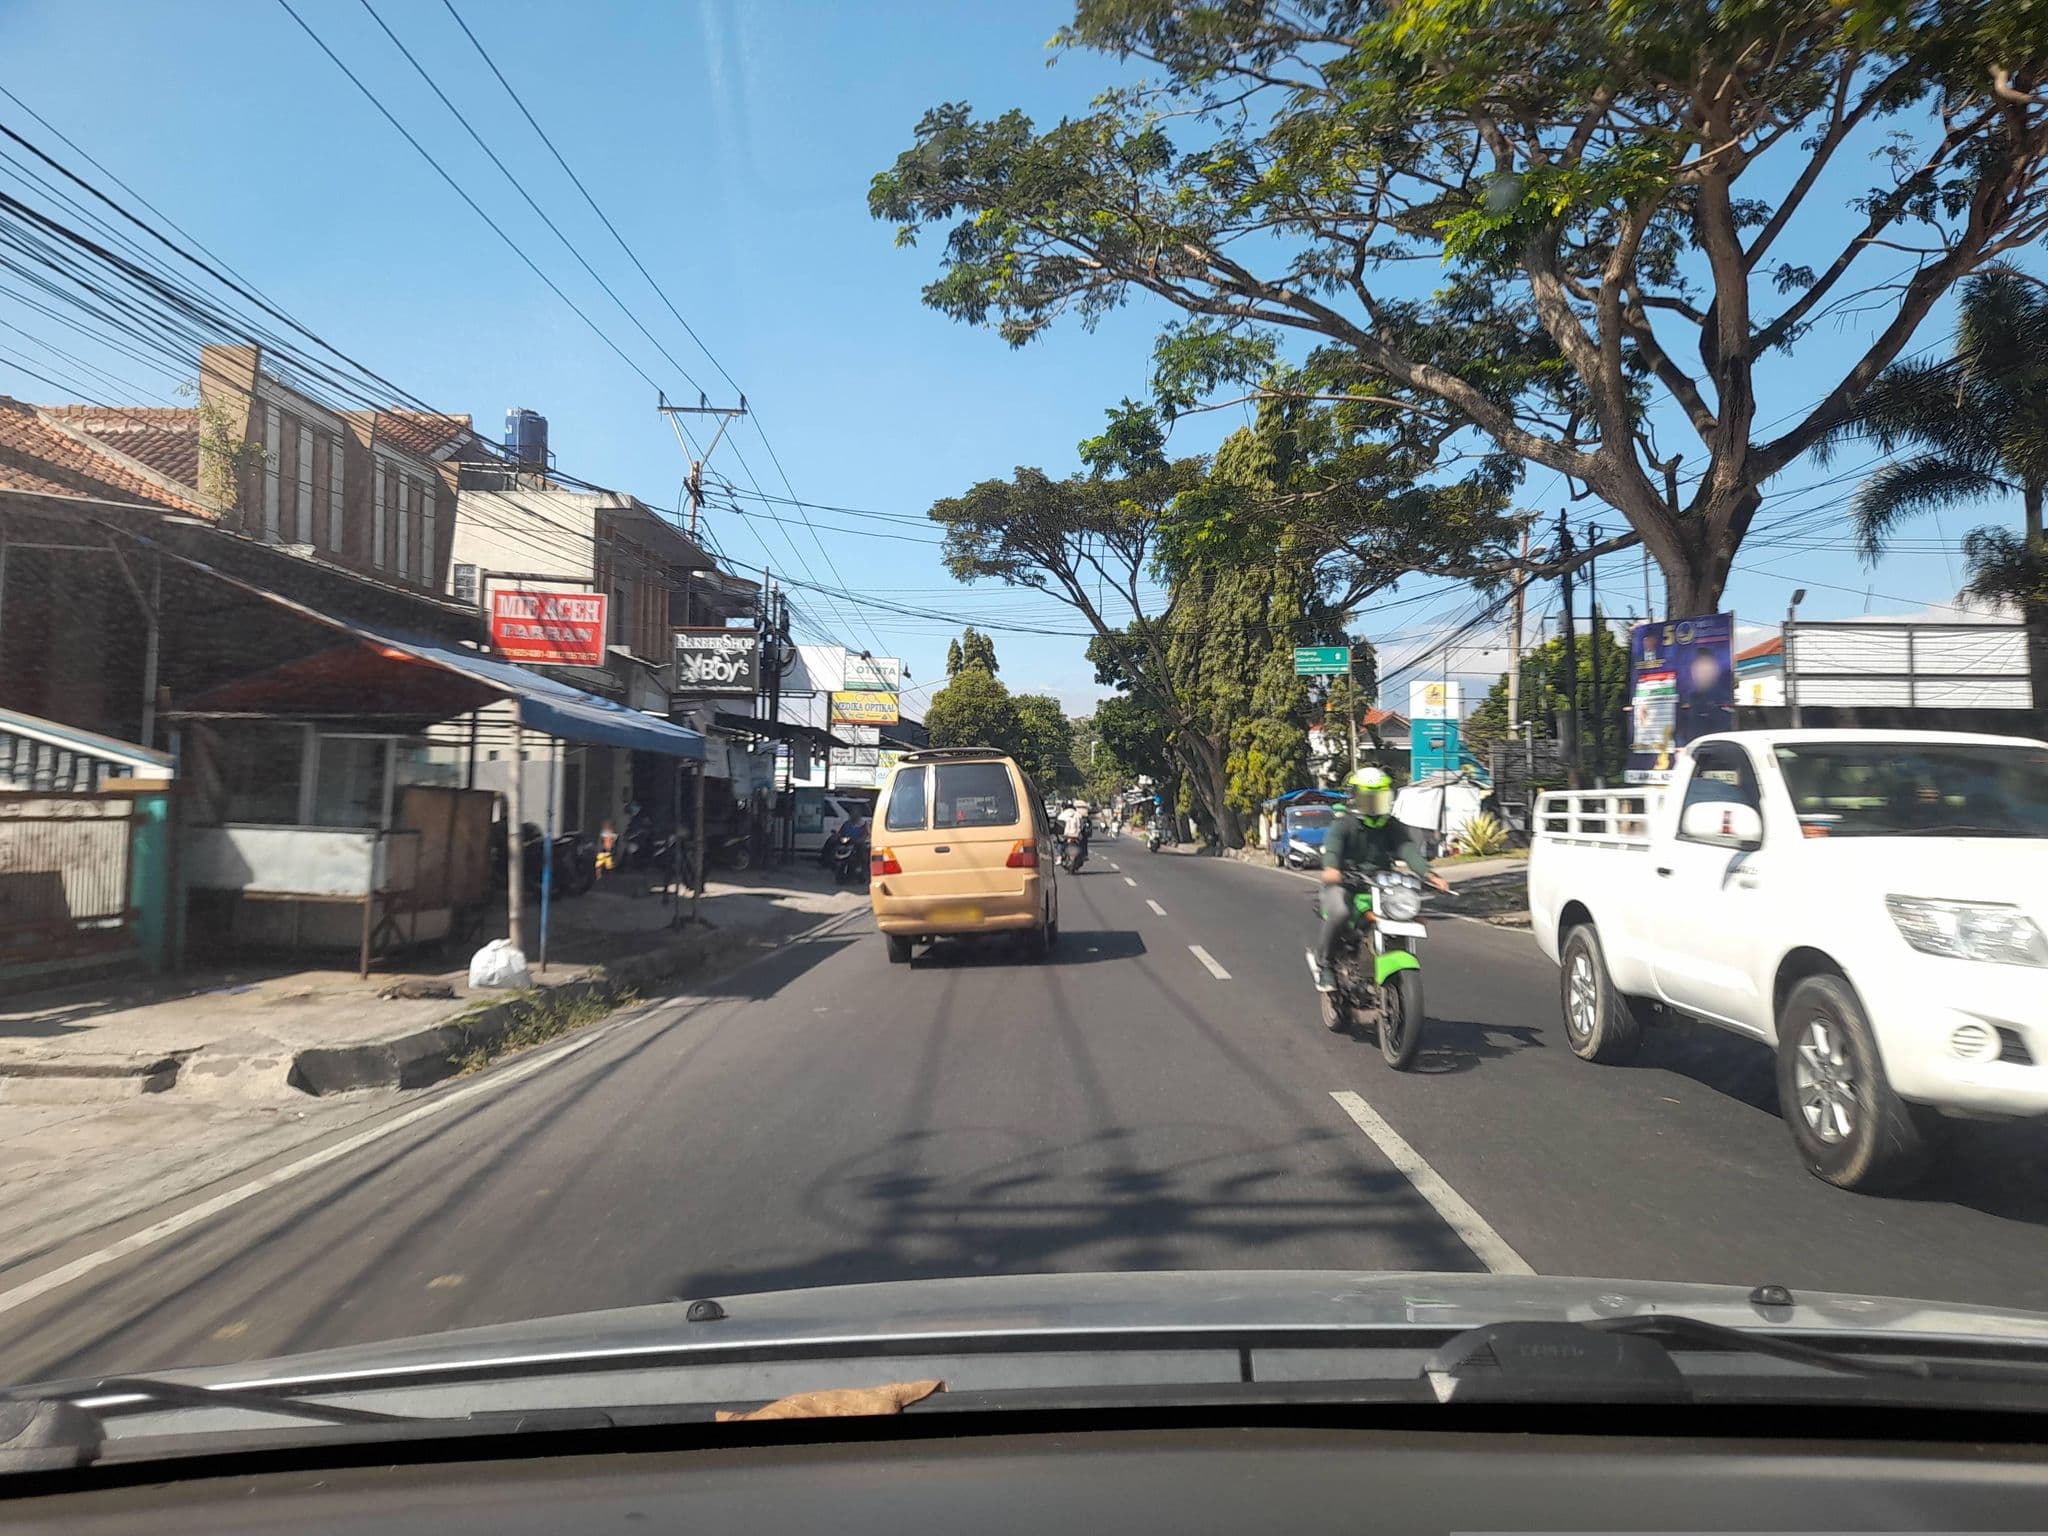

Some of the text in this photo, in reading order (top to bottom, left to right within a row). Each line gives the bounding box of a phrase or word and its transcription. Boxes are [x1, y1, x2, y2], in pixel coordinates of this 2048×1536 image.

[496, 595, 600, 623] MIE ACEH
[500, 623, 593, 643] FARHAN
[834, 702, 897, 713] MEDIKA OPTIKAL
